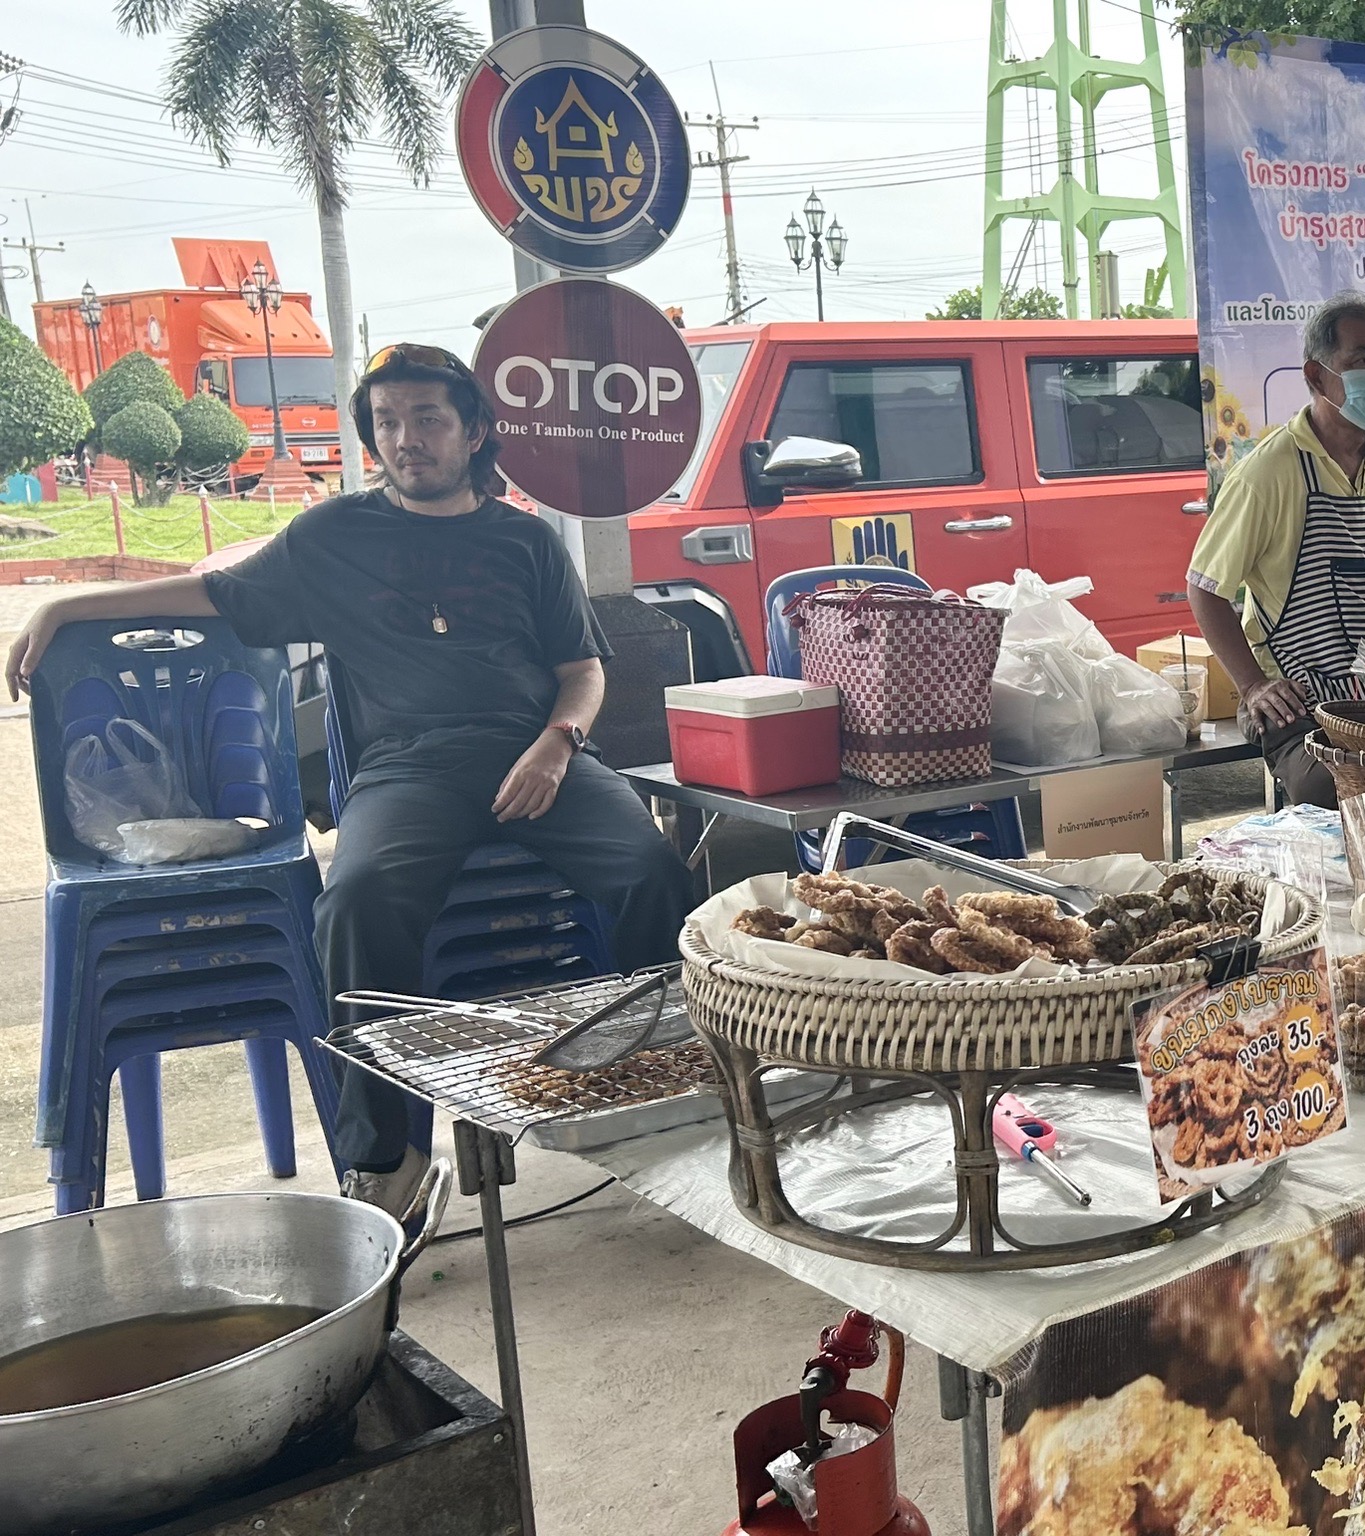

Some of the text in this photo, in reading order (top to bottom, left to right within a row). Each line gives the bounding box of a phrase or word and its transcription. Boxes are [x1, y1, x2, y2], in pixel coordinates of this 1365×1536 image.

[1245, 151, 1347, 188] โครงการ
[494, 355, 684, 417] OTOP
[495, 420, 685, 444] One Tambon One Product
[1057, 808, 1150, 835] สำนักงานพัฒนาชุมชนจังหวัด
[1151, 970, 1319, 1073] ขนมกงโบราณ
[1238, 1031, 1281, 1072] ถุงละ
[1246, 1110, 1260, 1140] 3
[1265, 1102, 1289, 1131] ถุง
